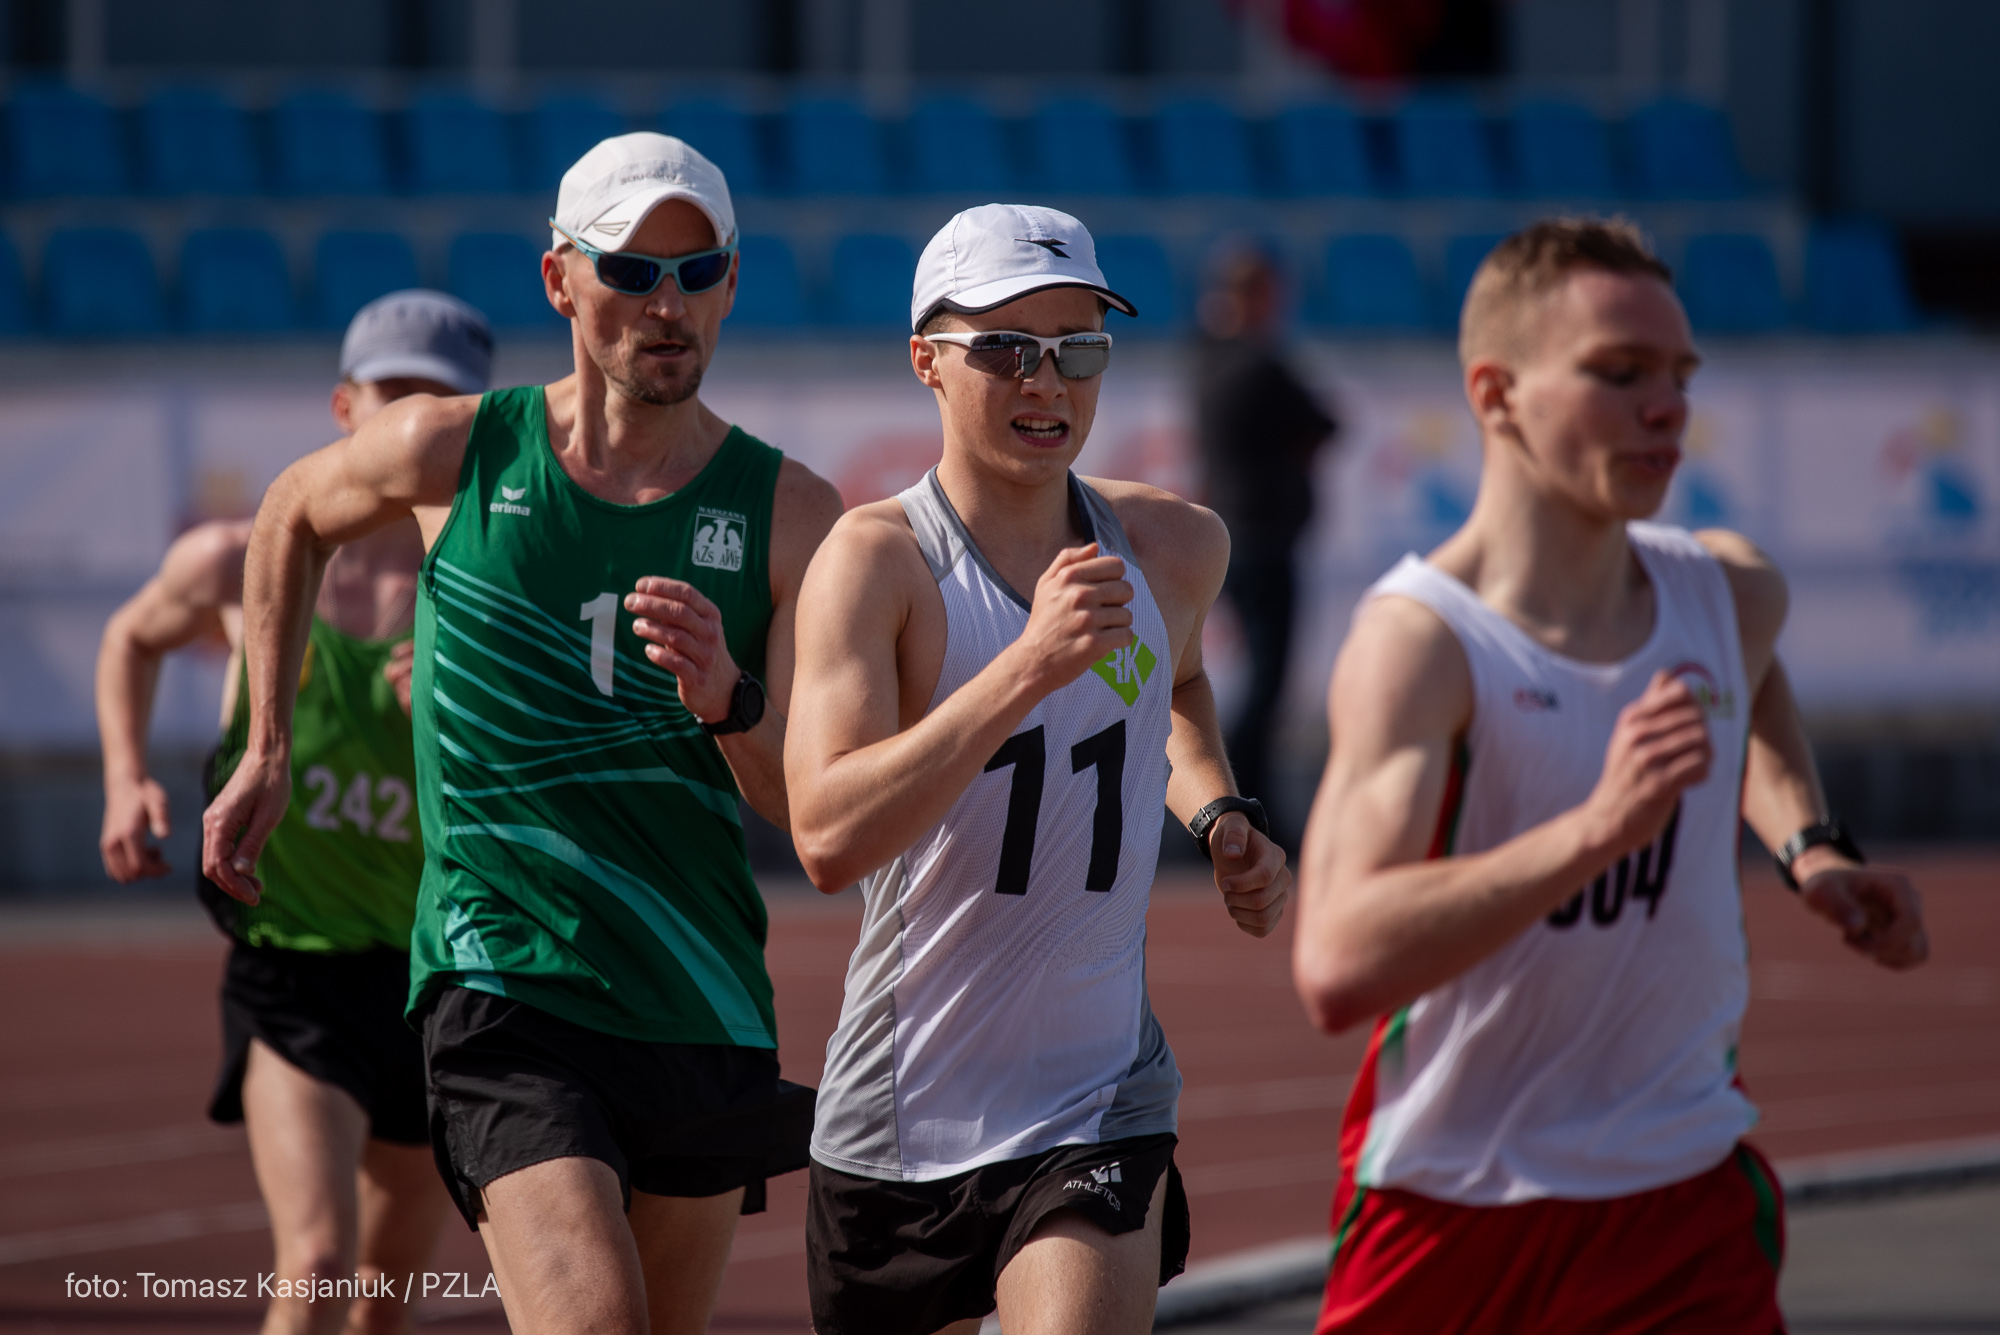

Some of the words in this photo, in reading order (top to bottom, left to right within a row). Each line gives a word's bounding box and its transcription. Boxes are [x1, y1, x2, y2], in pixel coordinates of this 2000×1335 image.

[489, 501, 531, 517] erima
[693, 545, 715, 563] AZS
[579, 591, 619, 698] 1
[304, 763, 413, 843] 242
[983, 719, 1127, 896] 11
[1546, 792, 1685, 932] 04
[1062, 1180, 1121, 1212] ATHLETICS
